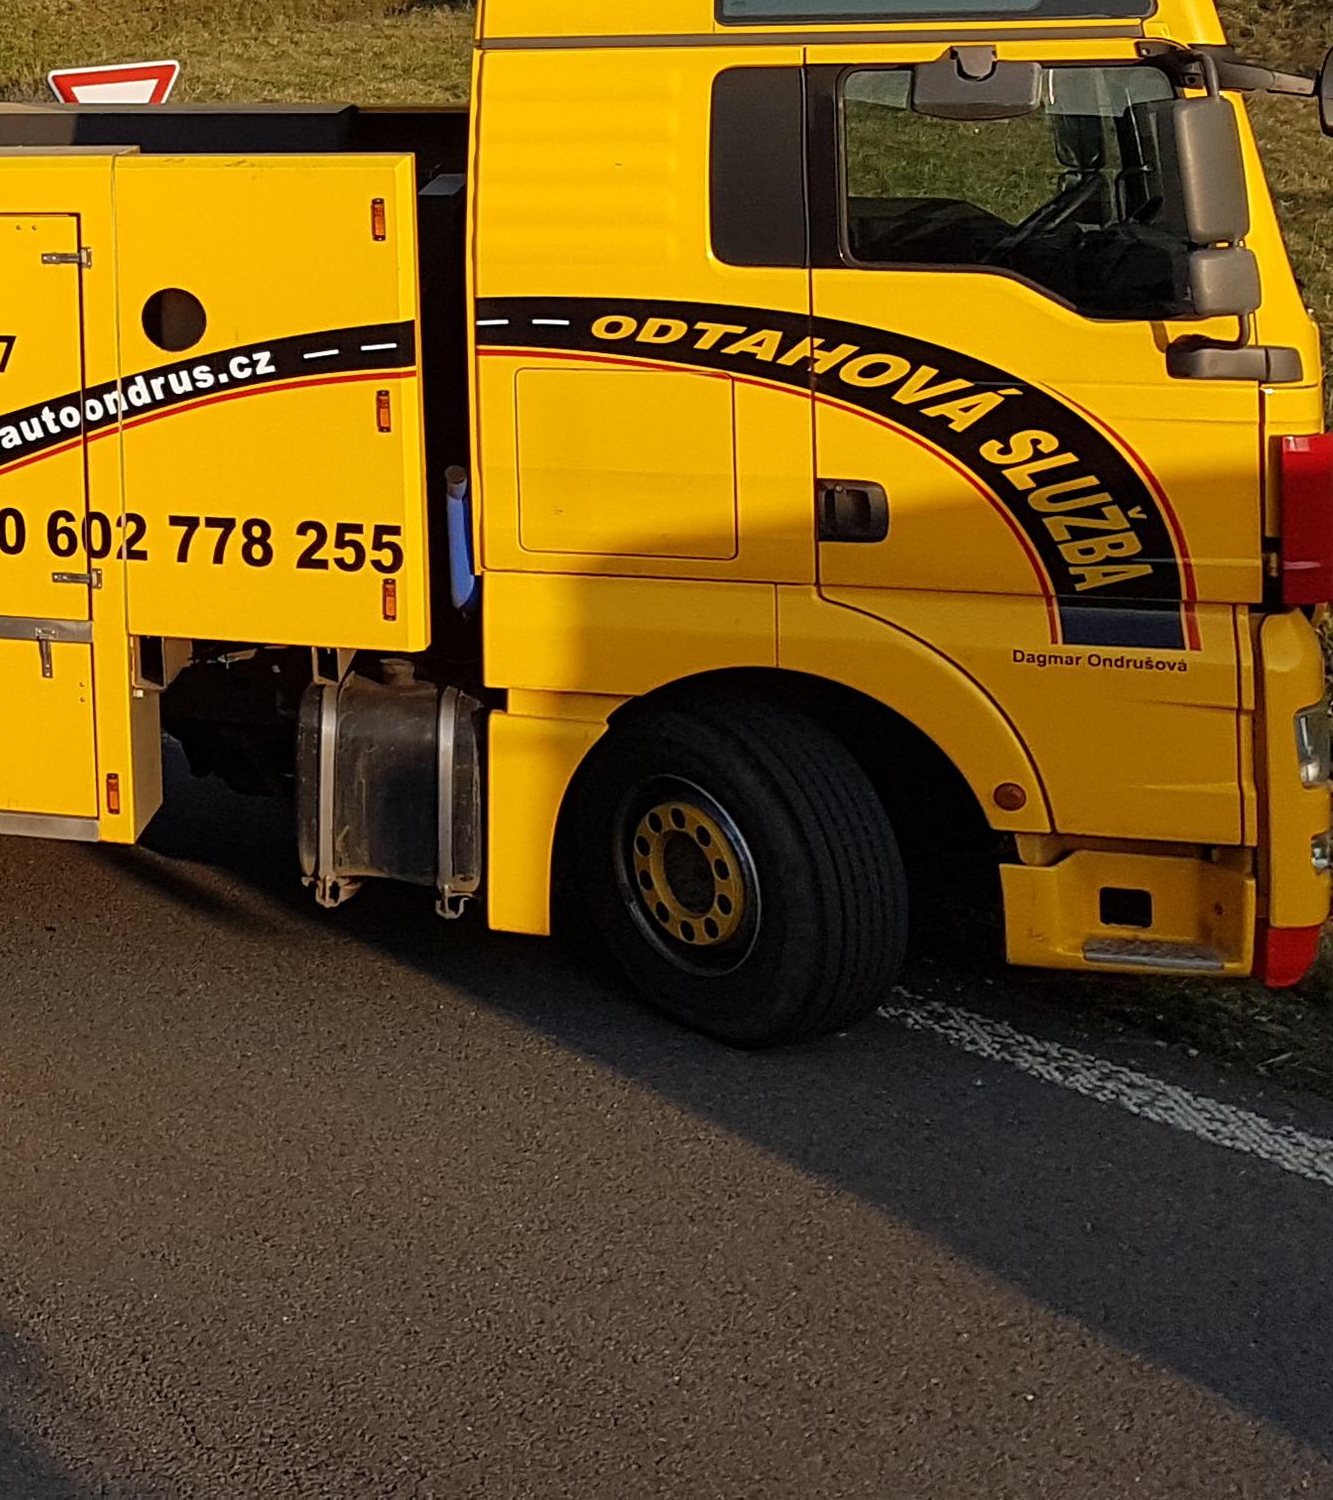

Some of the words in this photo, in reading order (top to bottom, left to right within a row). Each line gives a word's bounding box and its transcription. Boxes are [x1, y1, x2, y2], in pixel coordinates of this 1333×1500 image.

[590, 314, 1018, 434] ODTAHOVÁ
[46, 509, 148, 561] 602
[169, 514, 274, 568] 778
[294, 520, 405, 574] 255
[979, 429, 1153, 593] SLUŽBA
[1012, 649, 1082, 668] Dagmar
[1087, 653, 1188, 672] Ondrušová
